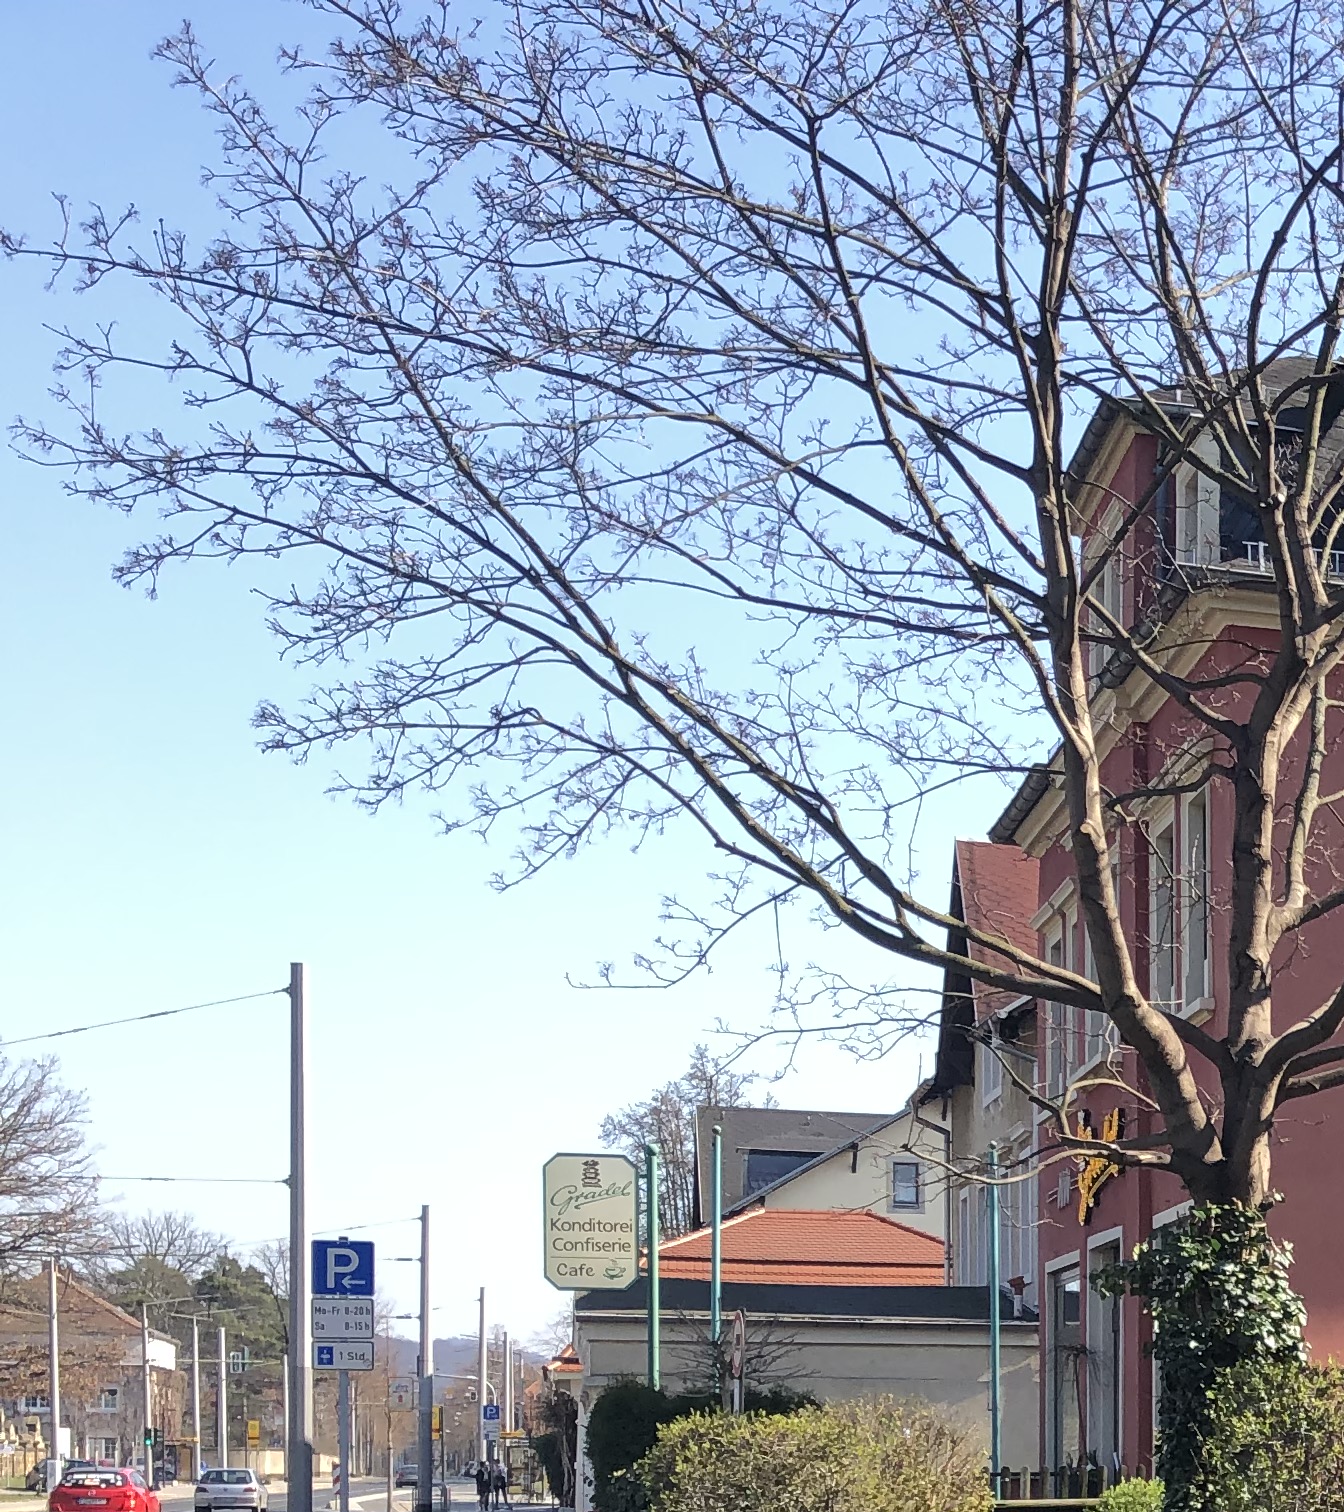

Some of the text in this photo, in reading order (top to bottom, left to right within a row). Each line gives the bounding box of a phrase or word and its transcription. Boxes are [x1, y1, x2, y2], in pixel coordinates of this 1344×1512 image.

[550, 1180, 633, 1216] Gradel
[550, 1217, 633, 1233] Konditorei
[552, 1237, 632, 1252] Confiserie
[326, 1247, 360, 1289] P
[556, 1262, 596, 1277] Cafe
[314, 1306, 340, 1316] Mo-Fr
[314, 1321, 325, 1331] Sa
